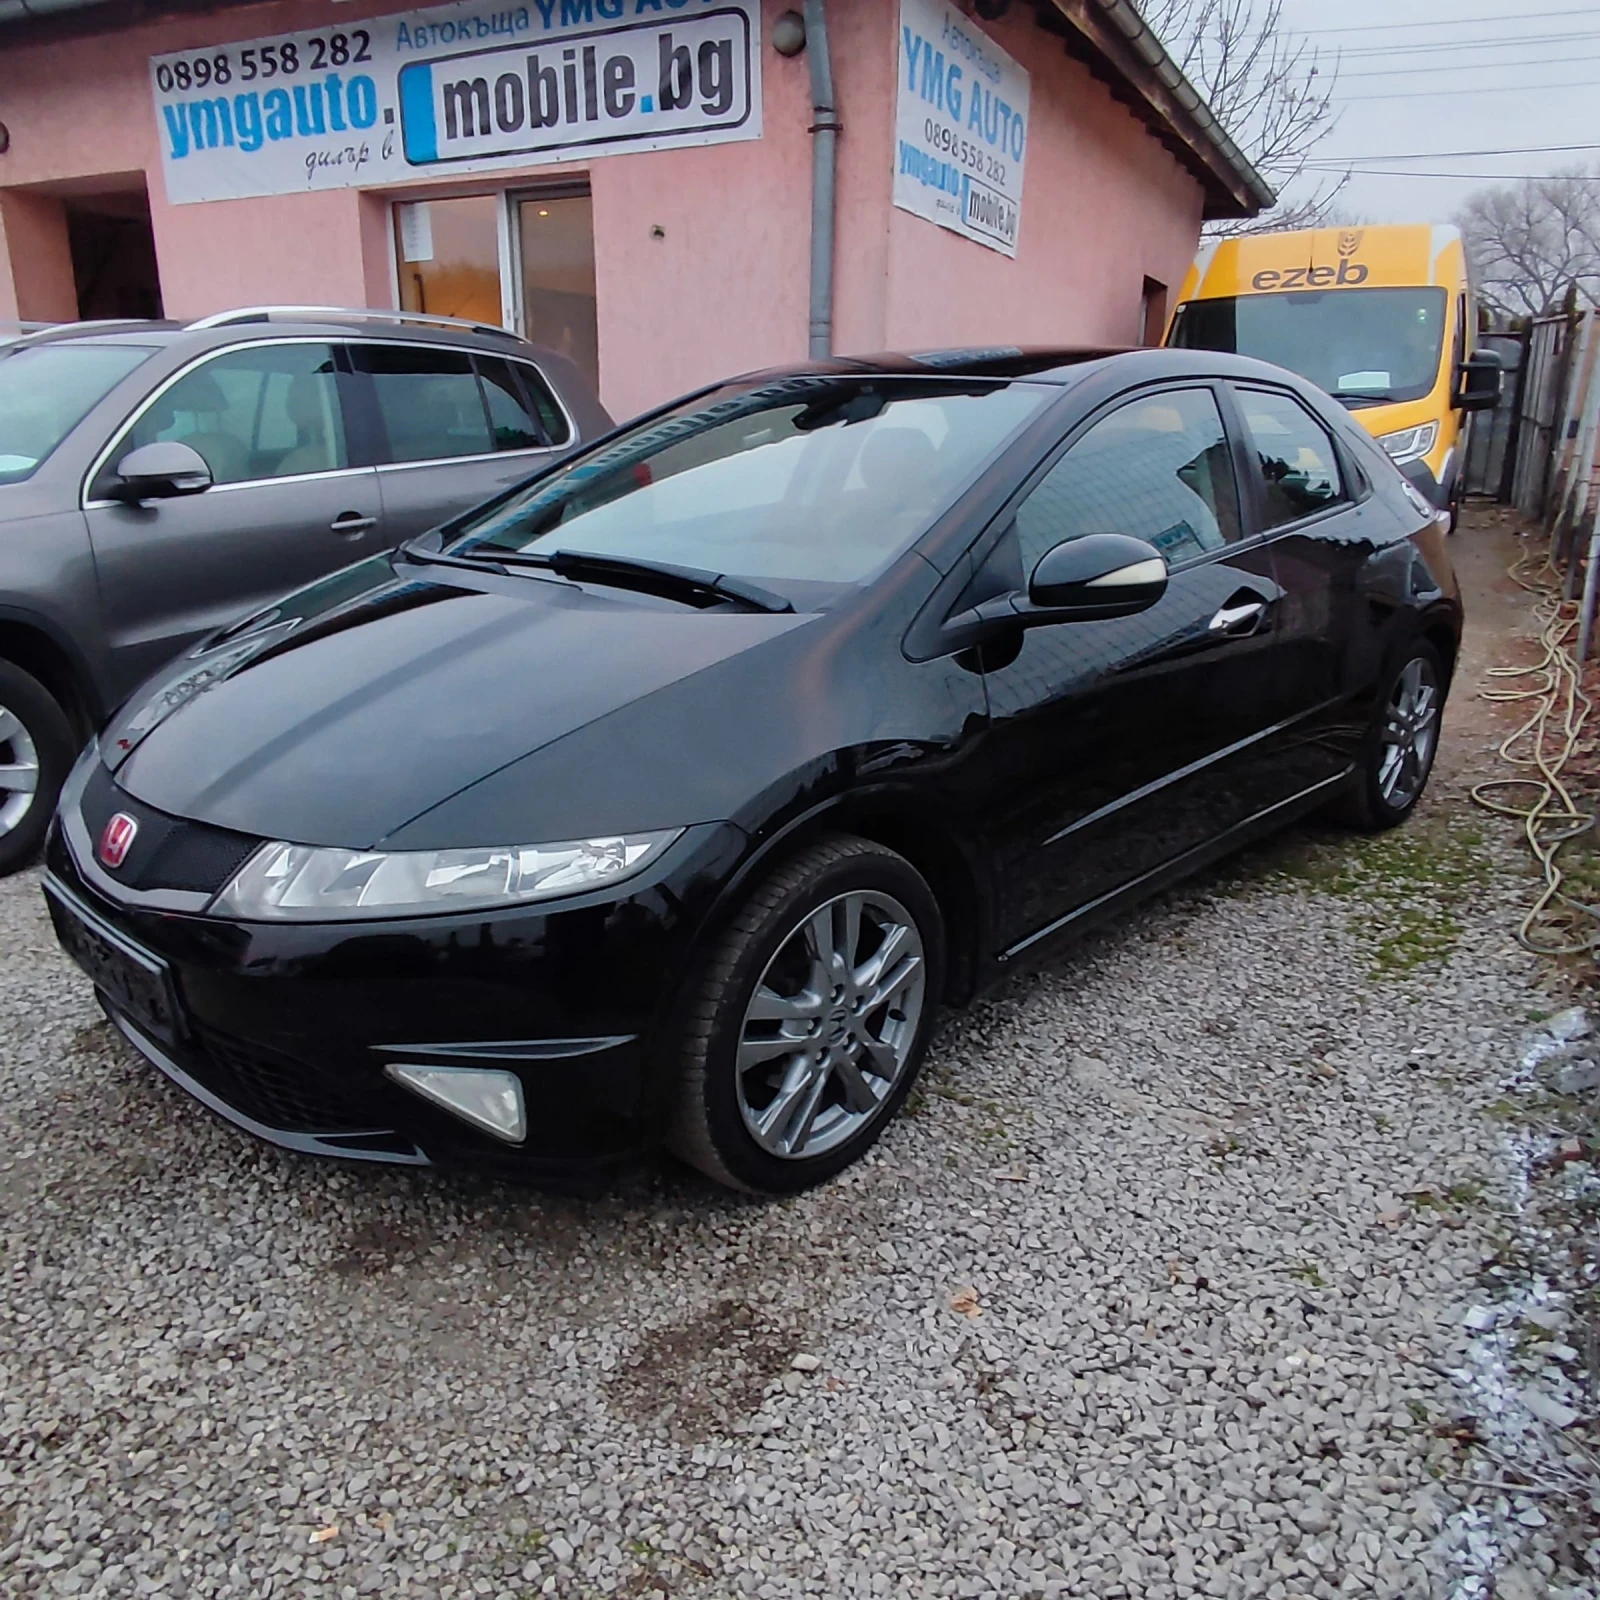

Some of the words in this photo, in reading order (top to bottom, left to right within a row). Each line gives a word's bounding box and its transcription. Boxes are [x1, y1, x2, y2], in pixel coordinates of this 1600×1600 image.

[156, 54, 232, 93] 0898
[240, 42, 300, 81] 558
[308, 29, 373, 70] 282
[396, 7, 530, 51] Автокъща
[443, 33, 733, 140] mobile.bg
[903, 24, 963, 123] YMG
[967, 79, 1024, 163] AUTO
[305, 141, 372, 181] дилър
[924, 117, 959, 157] 0898
[959, 141, 984, 173] 558
[985, 155, 1006, 186] 282
[1251, 258, 1369, 291] ezeb
